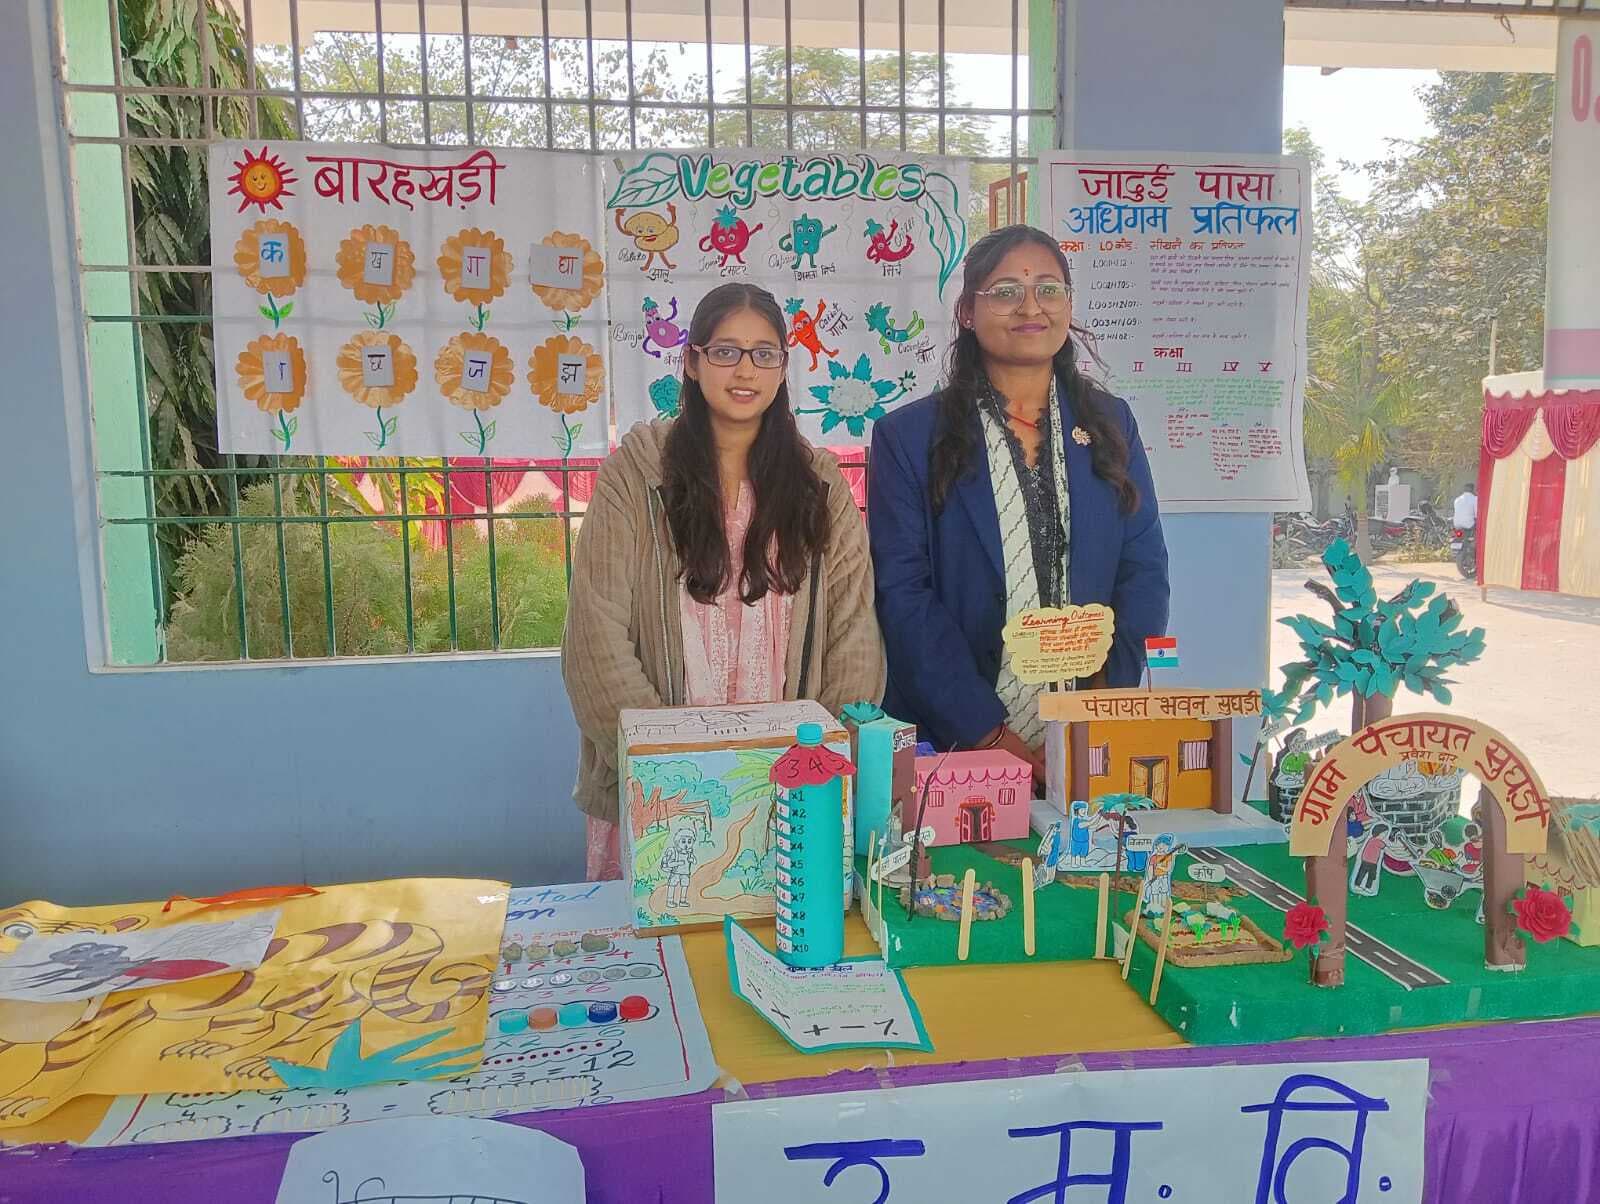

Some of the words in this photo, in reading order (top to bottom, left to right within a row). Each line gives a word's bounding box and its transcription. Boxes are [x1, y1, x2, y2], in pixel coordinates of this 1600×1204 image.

[306, 149, 506, 210] बारहखड़ी
[678, 153, 927, 210] Vegetables
[1078, 164, 1175, 203] जादुई
[1195, 170, 1275, 202] पासा
[1061, 201, 1172, 235] अधिगम
[1191, 201, 1300, 235] प्रतिफल
[261, 241, 284, 263] क
[1153, 346, 1184, 359] कक्षा
[1021, 614, 1069, 628] Learning
[1081, 696, 1149, 717] पंचायत
[1154, 695, 1210, 717] भवन
[787, 759, 800, 779] 3
[808, 757, 823, 775] 4
[1299, 759, 1347, 826] ग्राम
[1352, 720, 1476, 757] पंचायत
[580, 1051, 636, 1073] 12
